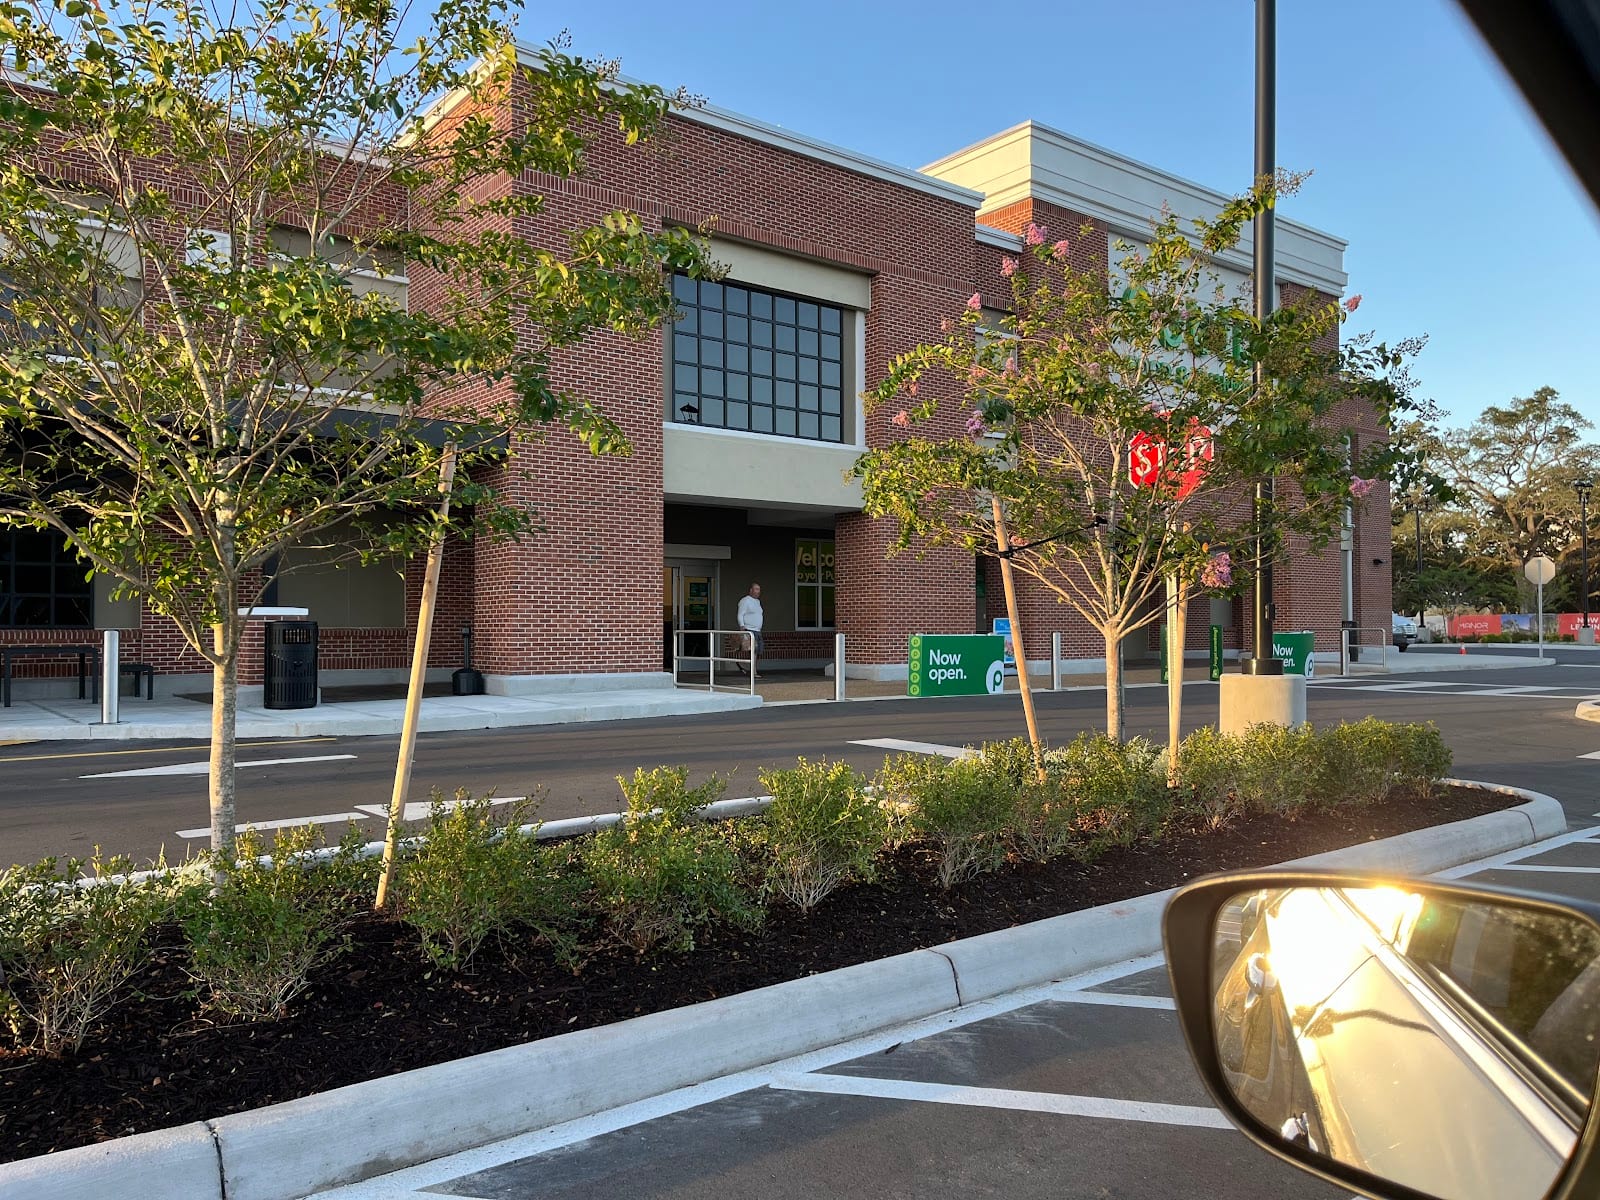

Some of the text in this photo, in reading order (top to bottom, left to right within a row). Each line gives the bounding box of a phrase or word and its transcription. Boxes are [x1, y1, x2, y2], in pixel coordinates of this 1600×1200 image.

[929, 649, 962, 665] Now
[1272, 643, 1293, 656] Now
[928, 667, 967, 685] open.
